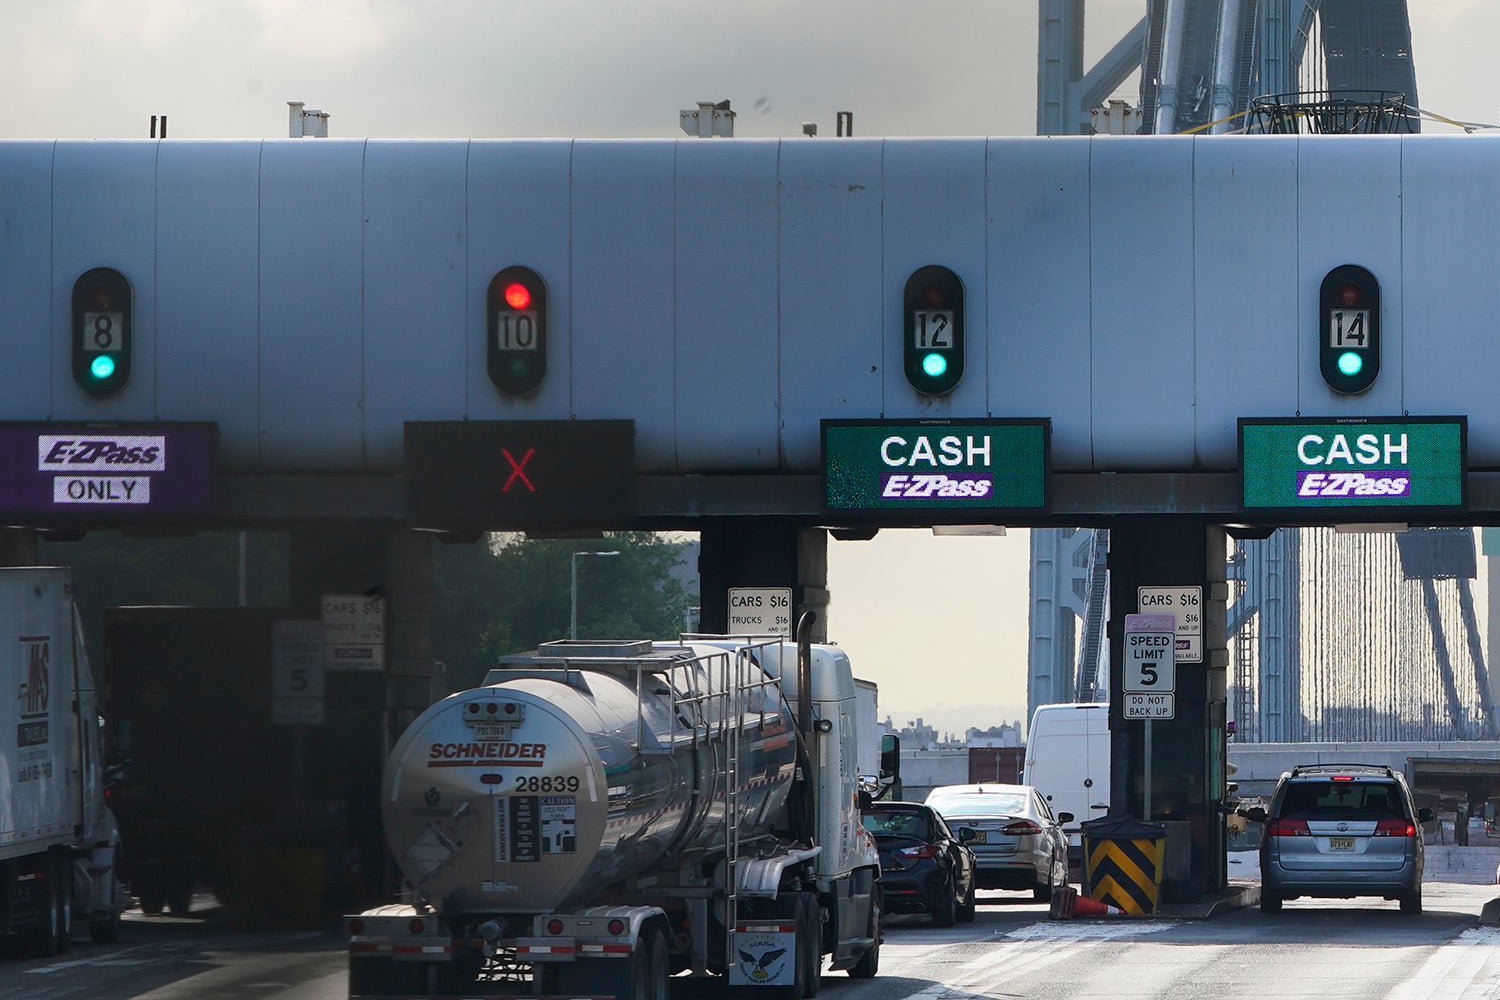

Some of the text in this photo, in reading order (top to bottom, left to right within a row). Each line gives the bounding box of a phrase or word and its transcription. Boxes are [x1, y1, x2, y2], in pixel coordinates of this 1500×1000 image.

[95, 314, 112, 349] 8
[503, 315, 532, 348] 10
[919, 313, 947, 347] 12
[1336, 312, 1364, 346] 14
[881, 436, 990, 466] CASH
[1298, 434, 1407, 465] CASH
[67, 479, 137, 500] ONLY
[732, 595, 788, 608] CARS $16
[1141, 594, 1199, 606] CARS $16
[732, 615, 788, 624] TRUCKS $16
[1185, 613, 1199, 623] $16
[1130, 636, 1170, 646] SPEED
[1134, 649, 1165, 659] LIMIT
[289, 667, 308, 692] 5
[1140, 662, 1158, 686] 5
[1132, 696, 1165, 704] DO NOT
[1129, 707, 1168, 715] BACK UP
[429, 743, 547, 759] SCHNEIDER
[515, 776, 580, 792] 28839
